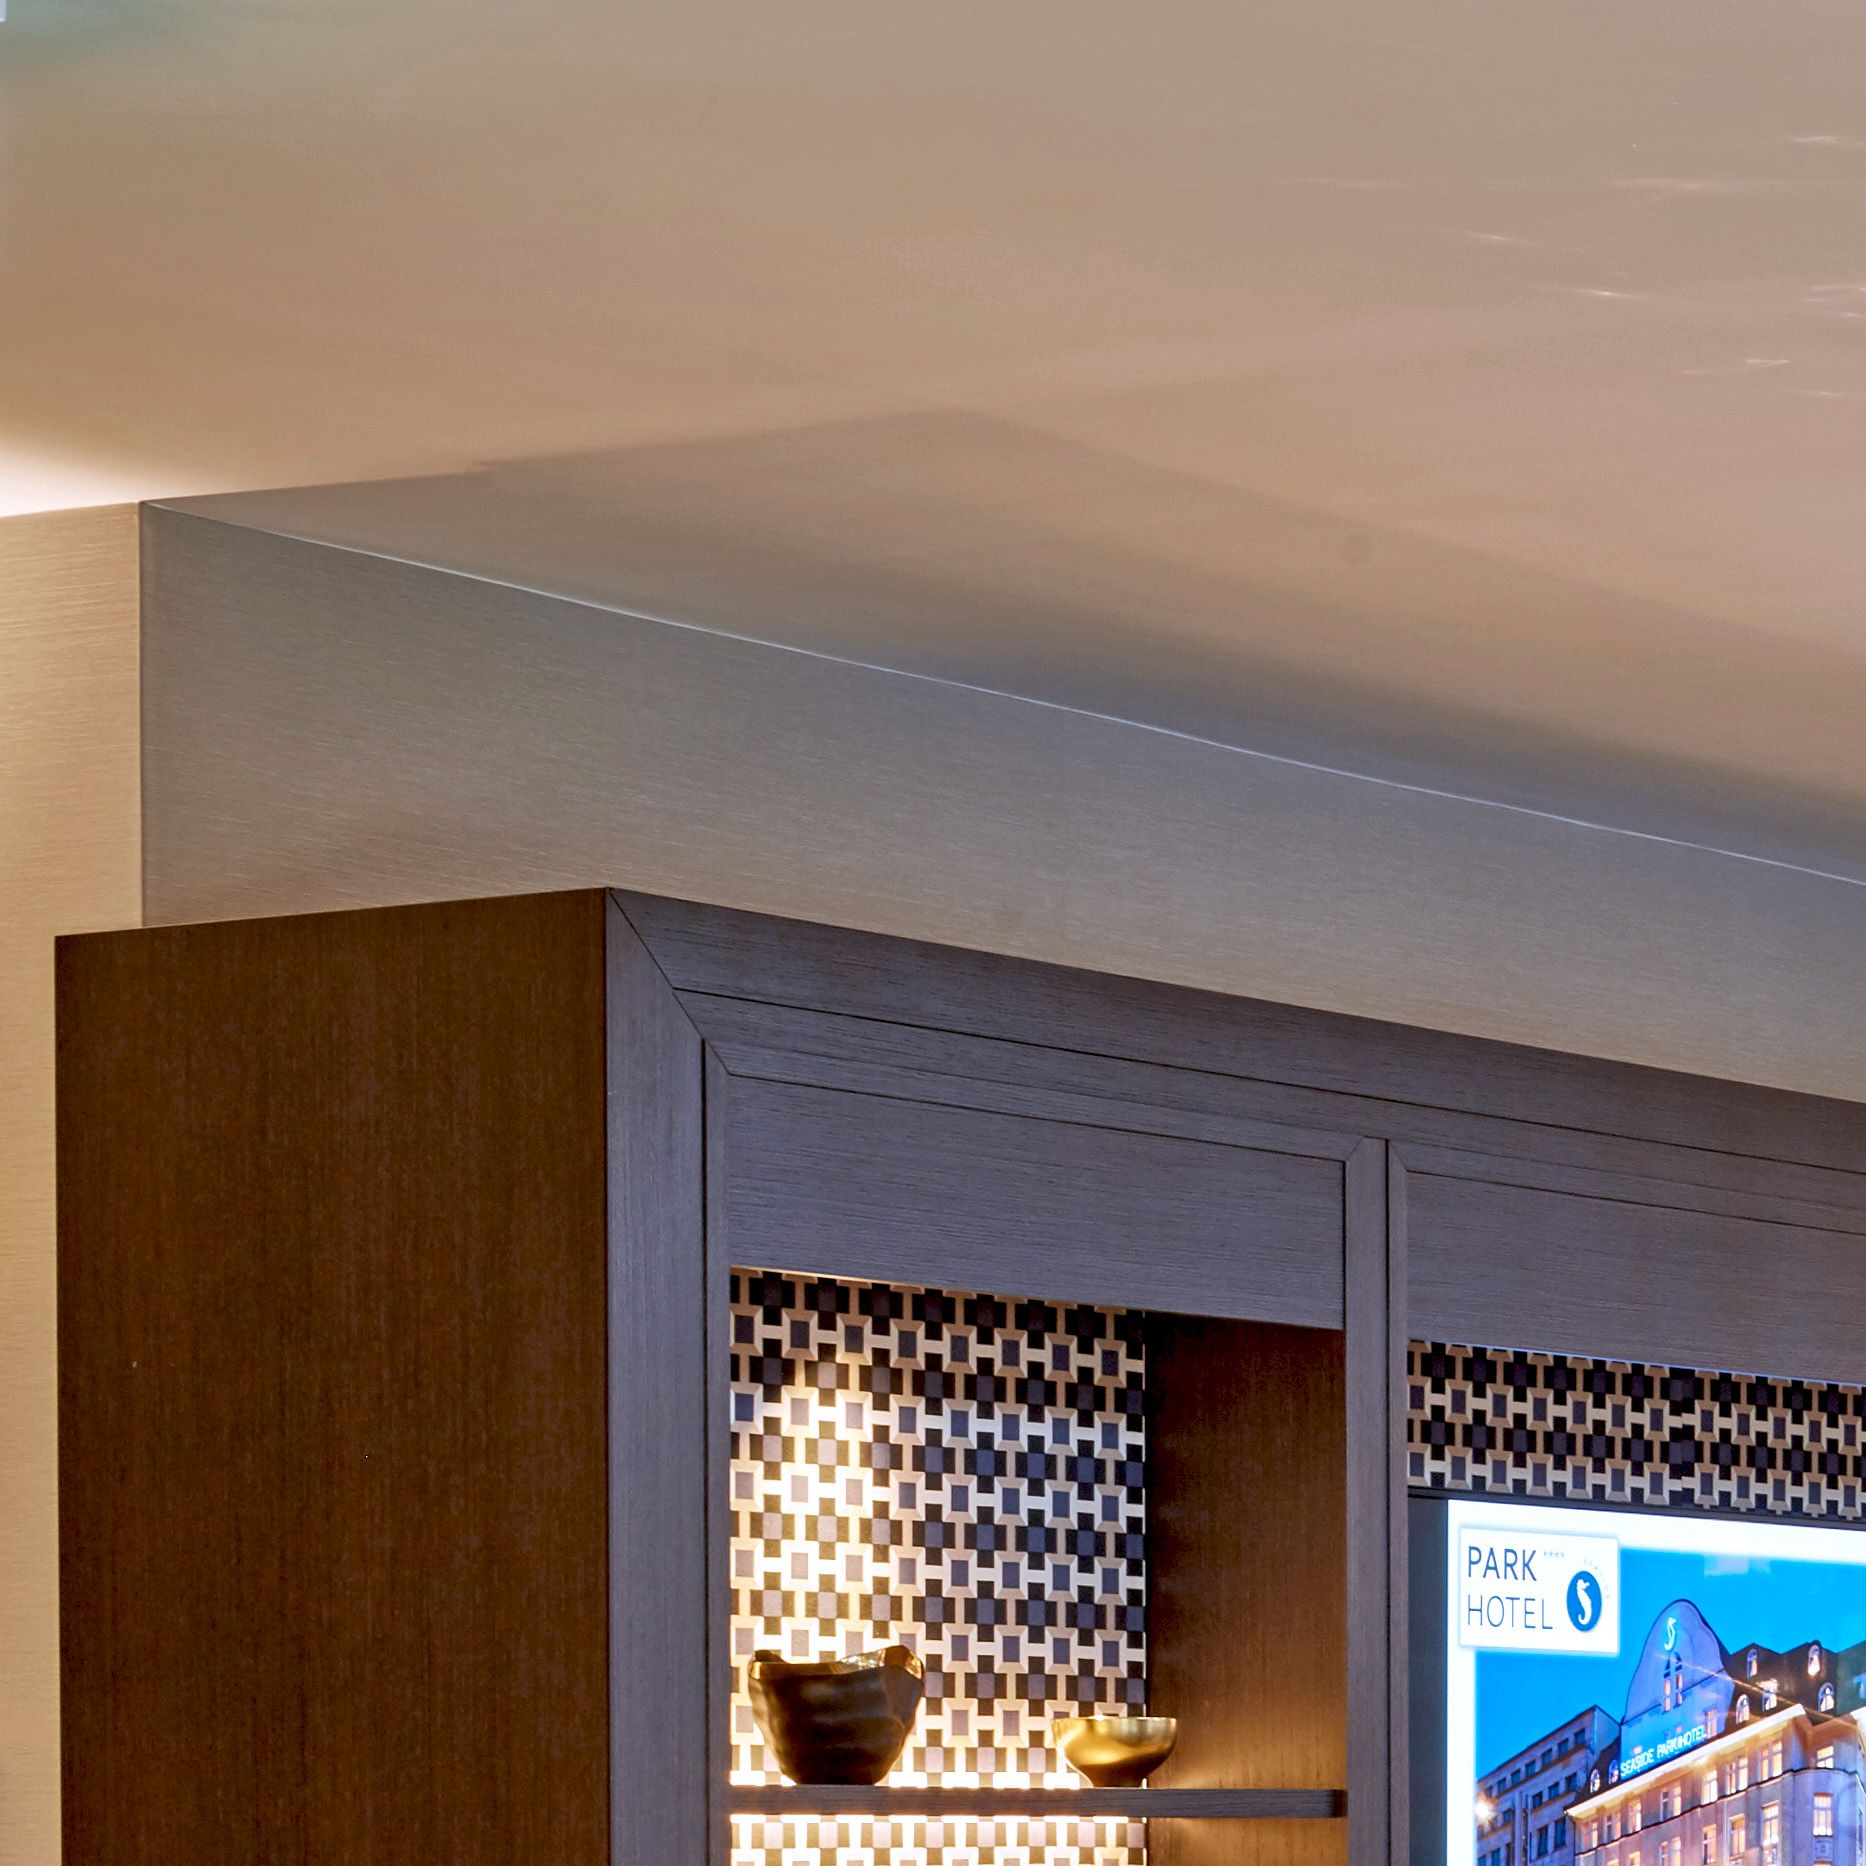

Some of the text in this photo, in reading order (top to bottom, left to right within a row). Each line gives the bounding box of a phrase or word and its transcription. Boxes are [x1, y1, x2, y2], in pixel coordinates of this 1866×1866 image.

[1468, 1545, 1537, 1581] PARK
[1467, 1594, 1553, 1630] HOTEL
[1620, 1725, 1707, 1777] SEASIDE PARK HOTEL
